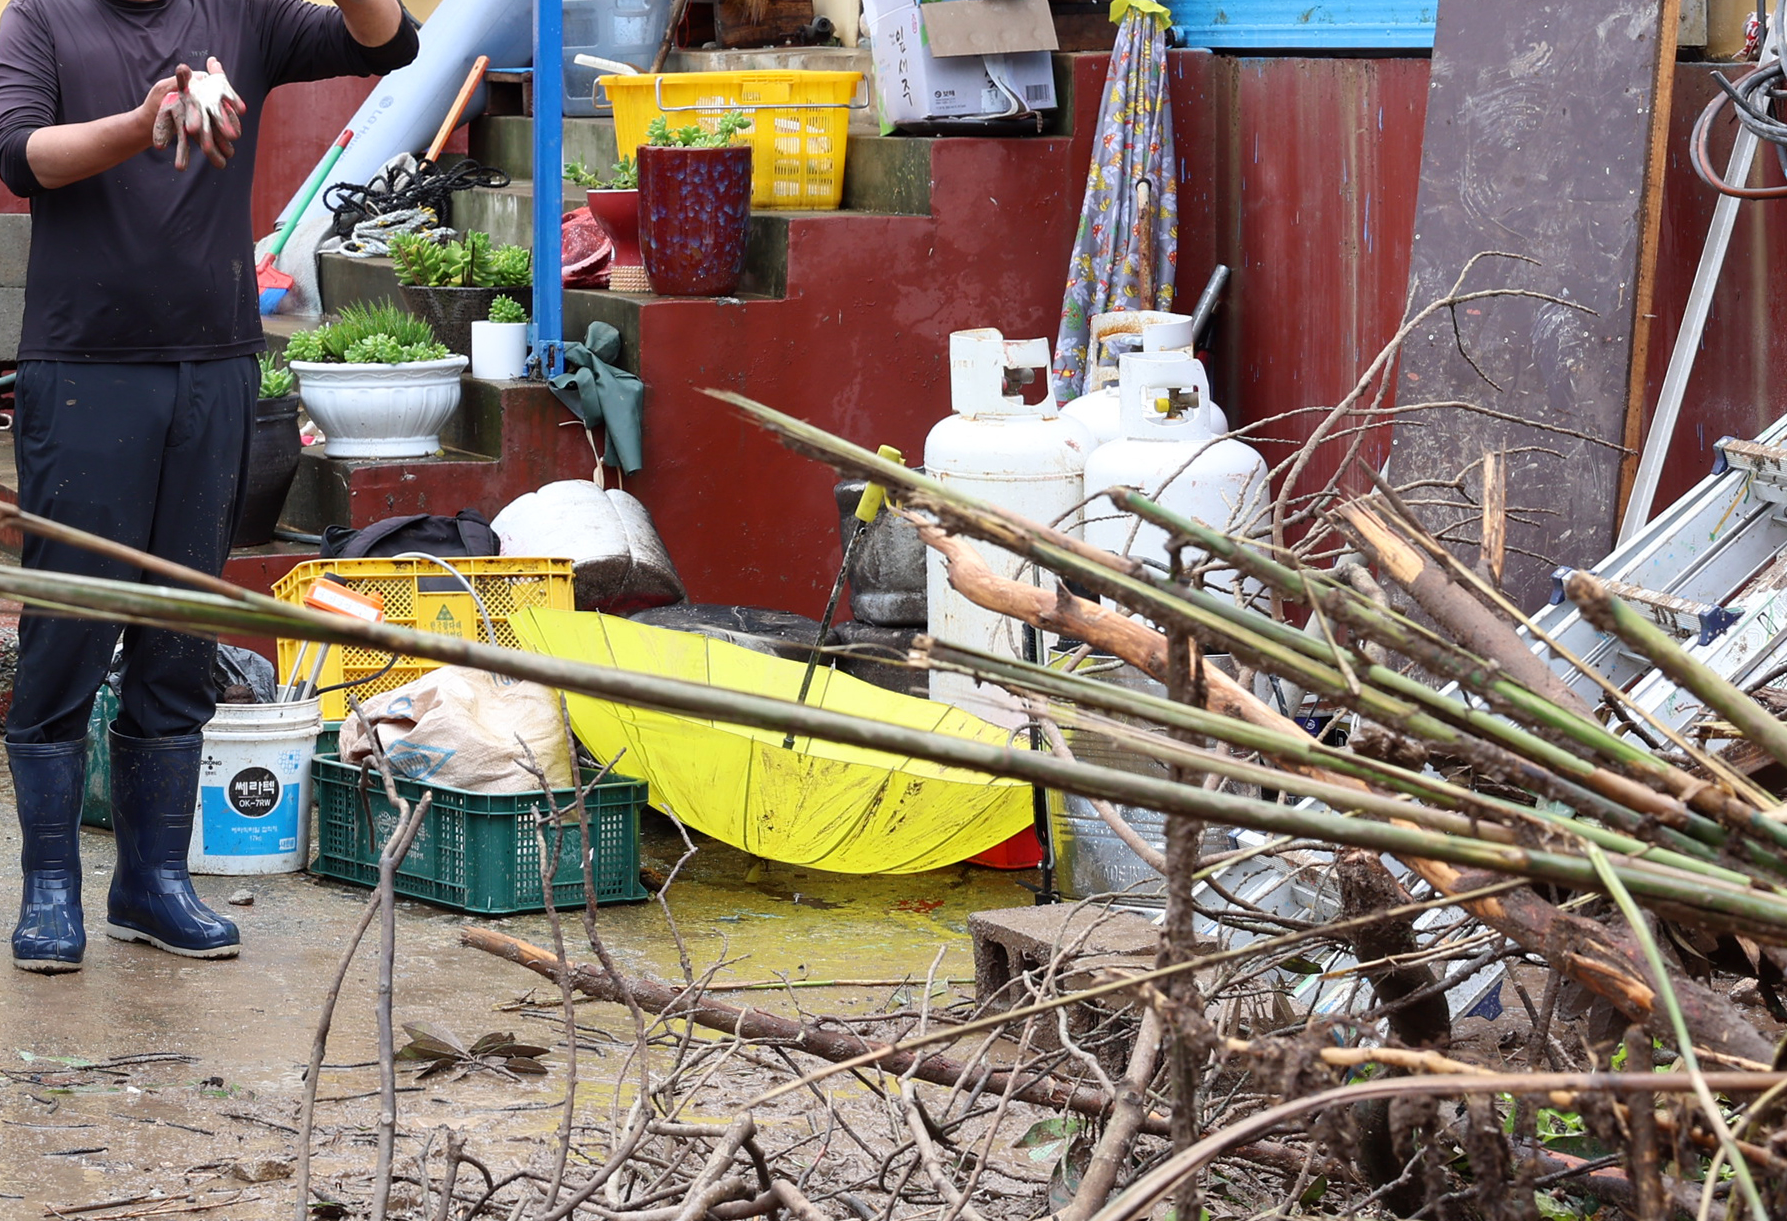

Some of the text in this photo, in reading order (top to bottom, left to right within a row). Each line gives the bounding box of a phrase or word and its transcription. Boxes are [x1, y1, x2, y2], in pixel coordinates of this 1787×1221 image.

[366, 109, 383, 125] LG
[234, 780, 275, 796] 쎄라텍
[238, 798, 272, 808] OK-7RW
